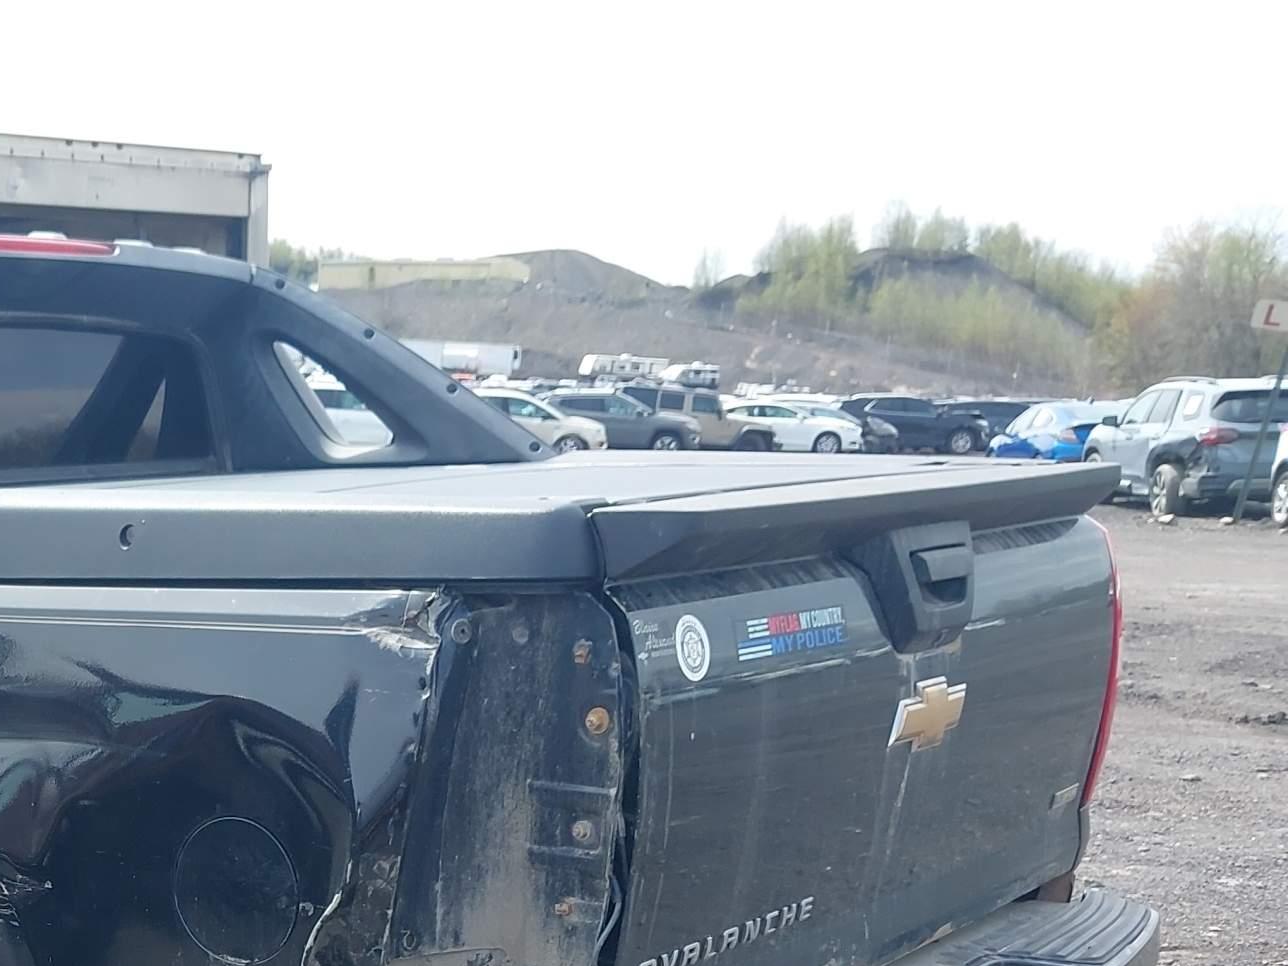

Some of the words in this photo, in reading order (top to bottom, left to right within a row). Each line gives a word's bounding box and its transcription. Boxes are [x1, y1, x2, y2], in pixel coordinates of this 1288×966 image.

[1263, 303, 1281, 327] L
[772, 633, 794, 655] MY
[796, 625, 848, 651] POLICE
